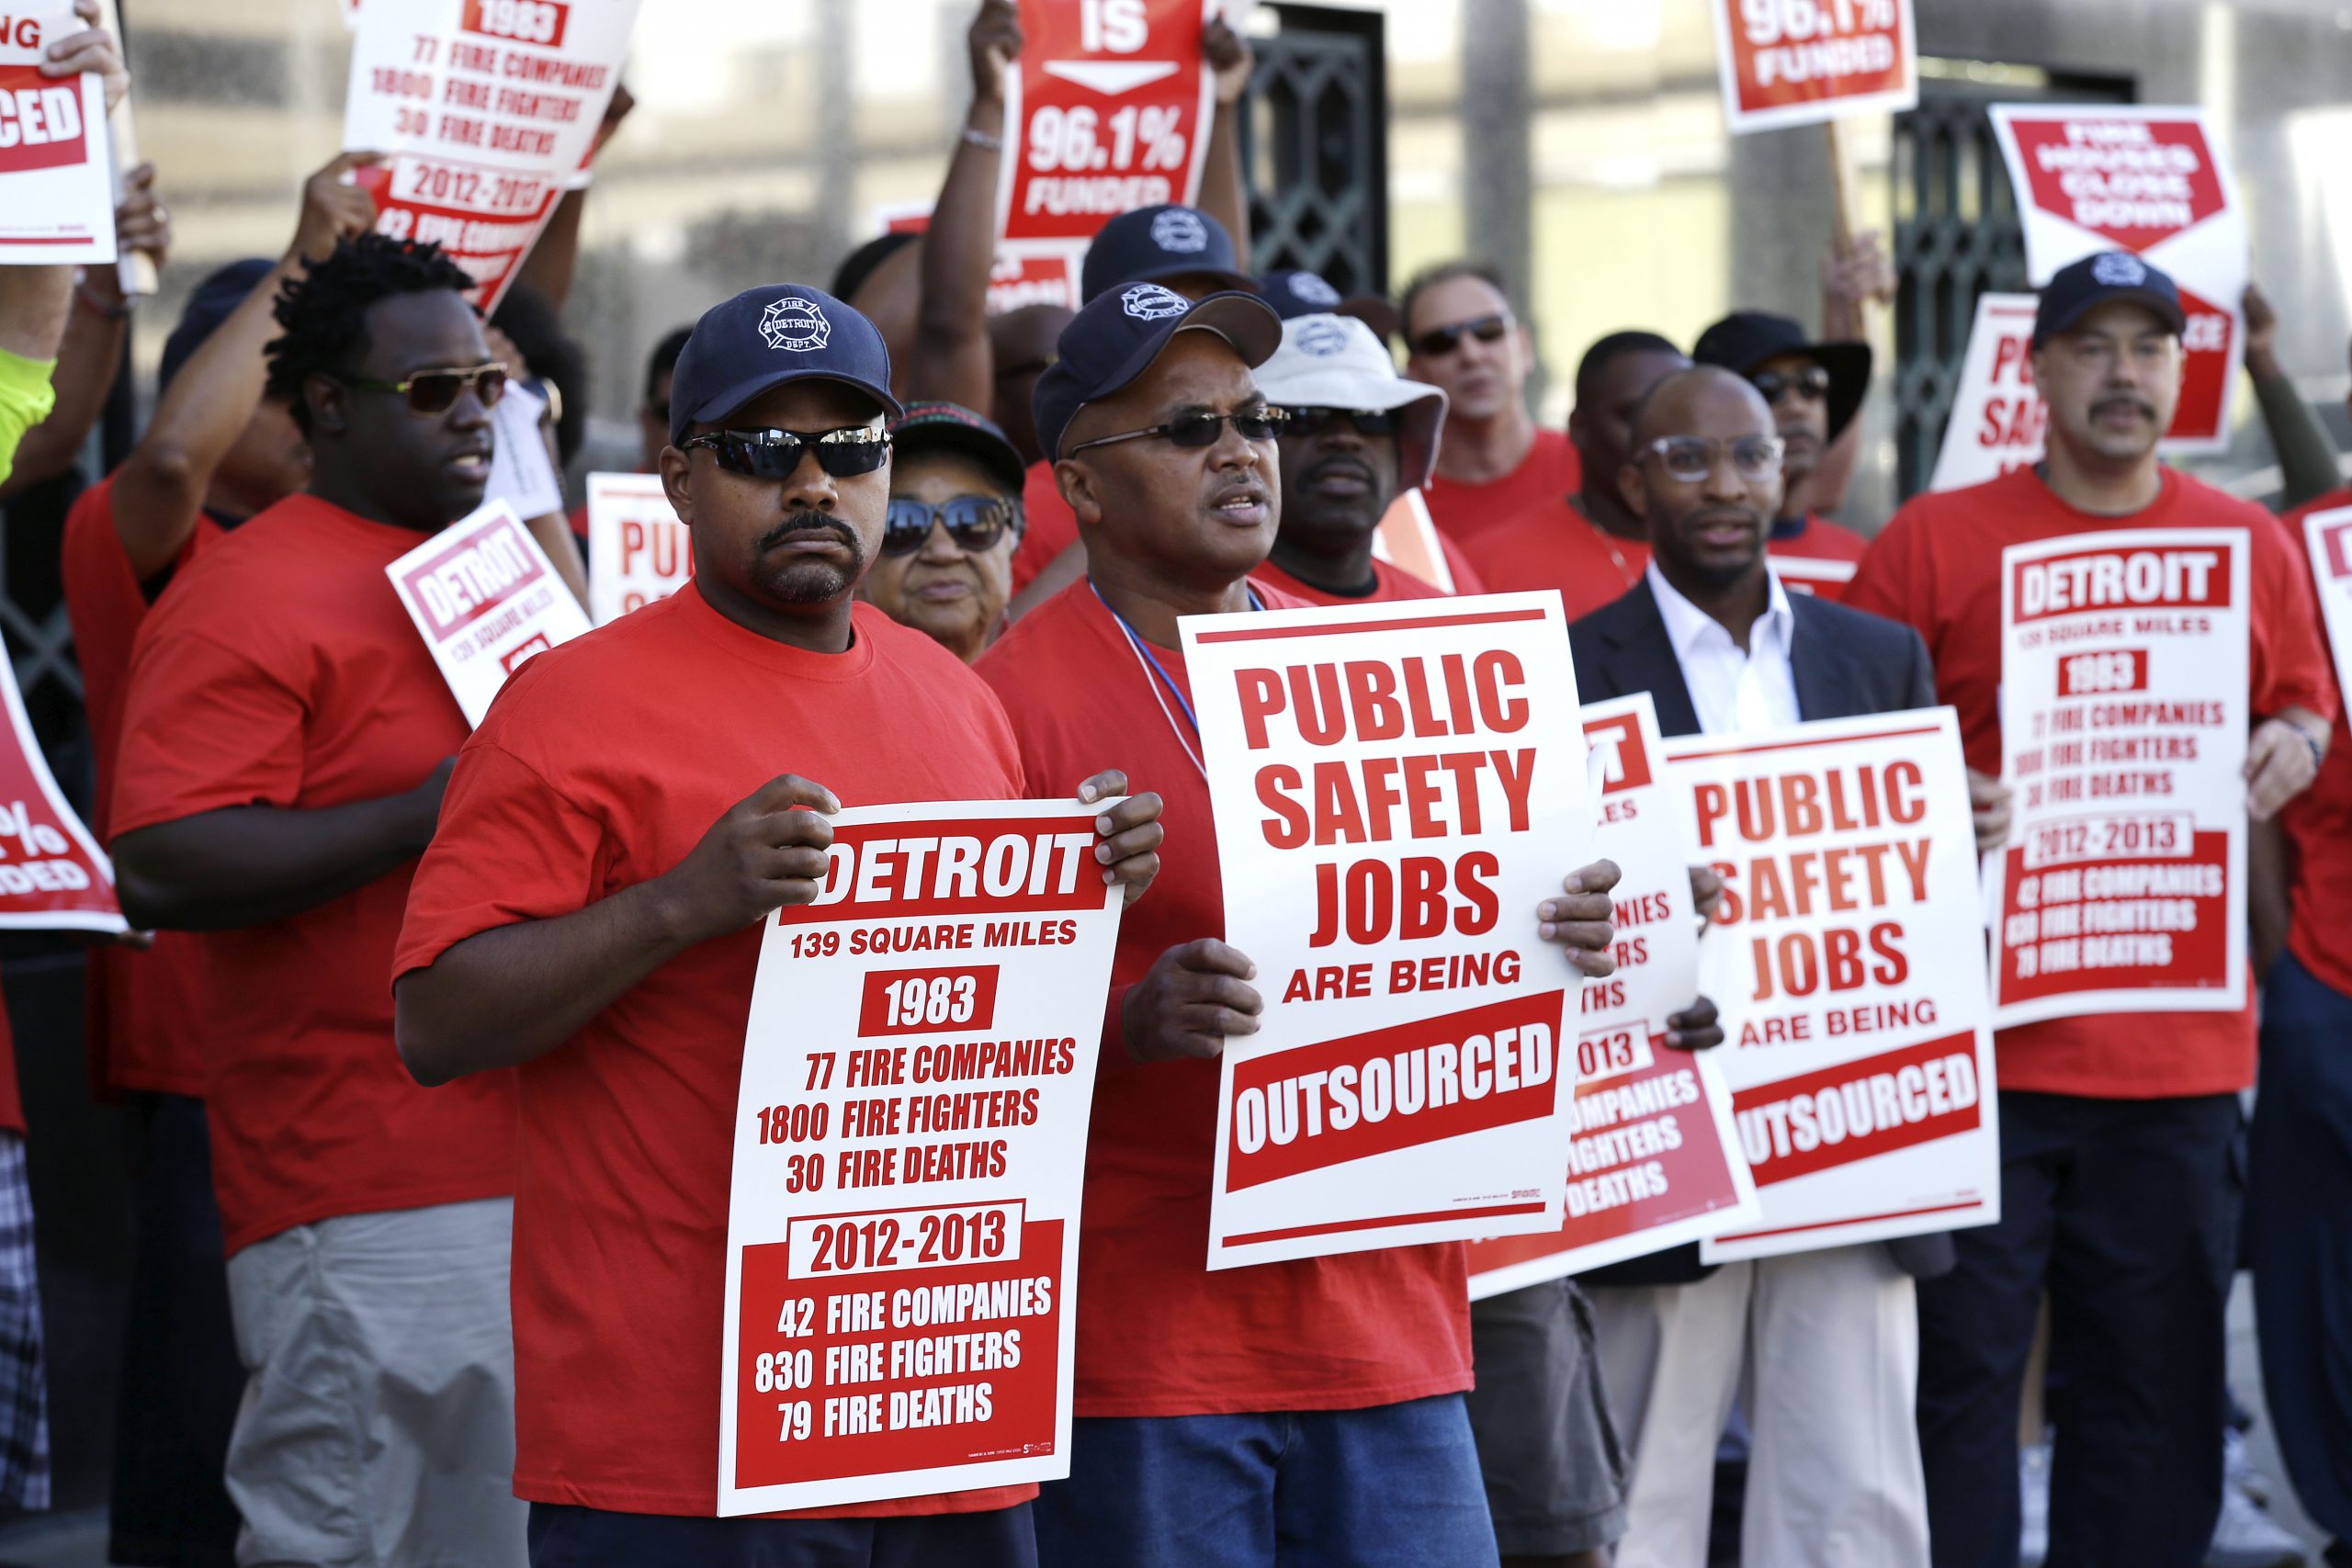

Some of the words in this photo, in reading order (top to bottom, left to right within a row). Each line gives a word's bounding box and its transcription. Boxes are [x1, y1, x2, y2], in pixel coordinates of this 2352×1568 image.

[1080, 0, 1148, 52] IS
[449, 41, 495, 73] FIRE
[444, 78, 490, 109] FIRE
[438, 115, 483, 145] FIRE
[1029, 106, 1185, 172] 96.1%
[1024, 176, 1171, 215] FUNDED
[775, 320, 817, 330] DETROIT
[416, 525, 534, 628] DETROIT
[2022, 552, 2218, 617] DETROIT
[2134, 616, 2211, 635] MILES
[1234, 649, 1530, 750] PUBLIC
[2090, 701, 2225, 727] COMPANIES
[2090, 736, 2198, 761] FIGHTERS
[1254, 748, 1537, 851] SAFETY
[1693, 761, 1926, 847] PUBLIC
[2090, 772, 2174, 796] DEATHS
[808, 832, 1094, 907] DETROIT
[1708, 838, 1932, 926] SAFETY
[2083, 864, 2224, 898] COMPANIES
[1309, 851, 1499, 948] JOBS
[791, 931, 840, 958] 139
[849, 924, 974, 954] SQUARE
[983, 919, 1078, 948] MILES
[1751, 921, 1909, 1002] JOBS
[884, 975, 978, 1027] 1983
[1282, 963, 1374, 1004] ARE
[1388, 950, 1521, 995] BEING
[1739, 1014, 1811, 1047] ARE
[1826, 998, 1939, 1036] BEING
[806, 1052, 837, 1091] 77
[846, 1047, 907, 1089] FIRE
[911, 1037, 1077, 1084] COMPANIES
[1235, 1021, 1554, 1155] OUTSOURCED
[756, 1102, 830, 1145] 1800
[842, 1097, 902, 1139] FIRE
[907, 1088, 1040, 1134] FIGHTERS
[1736, 1052, 1978, 1166] UTSOURCED
[786, 1153, 825, 1194] 30
[837, 1148, 897, 1190] FIRE
[902, 1139, 1008, 1185] DEATHS
[1567, 1115, 1683, 1176] IGHTERS
[1566, 1160, 1668, 1218] DEATHS
[810, 1210, 1006, 1273] 2012-2013
[777, 1297, 816, 1338] 42
[826, 1291, 887, 1335] FIRE
[891, 1276, 1052, 1329] COMPANIES
[754, 1348, 813, 1393] 830
[825, 1342, 884, 1386] FIRE
[890, 1328, 1021, 1380] FIGHTERS
[777, 1400, 812, 1442] 79
[824, 1393, 883, 1438] FIRE
[889, 1382, 993, 1432] DEATHS
